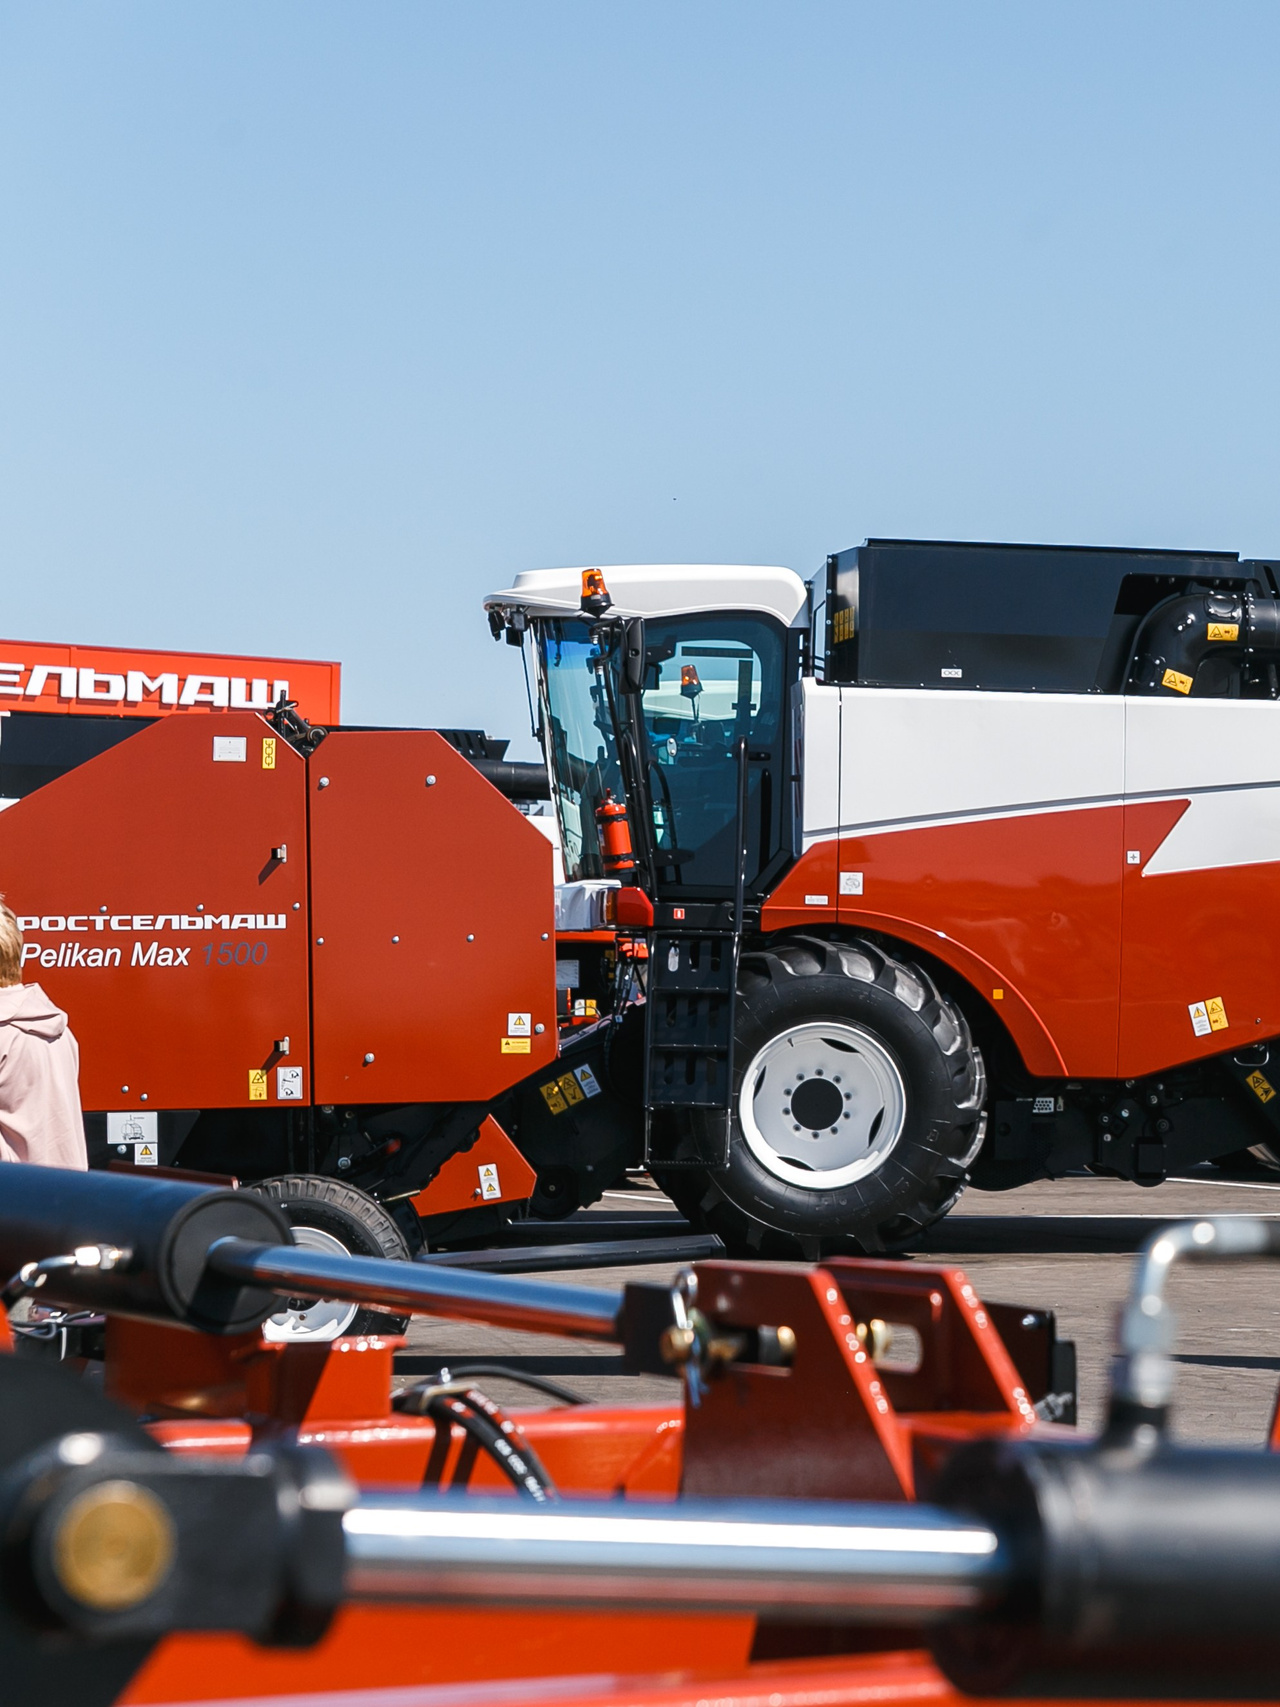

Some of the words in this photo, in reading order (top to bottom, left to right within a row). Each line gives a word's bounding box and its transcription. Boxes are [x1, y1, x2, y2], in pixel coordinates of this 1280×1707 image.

[17, 914, 287, 932] РОСТСЕЛЬМАШ
[20, 942, 122, 968] Pelikan
[130, 941, 191, 967] Max
[202, 941, 268, 966] 1500
